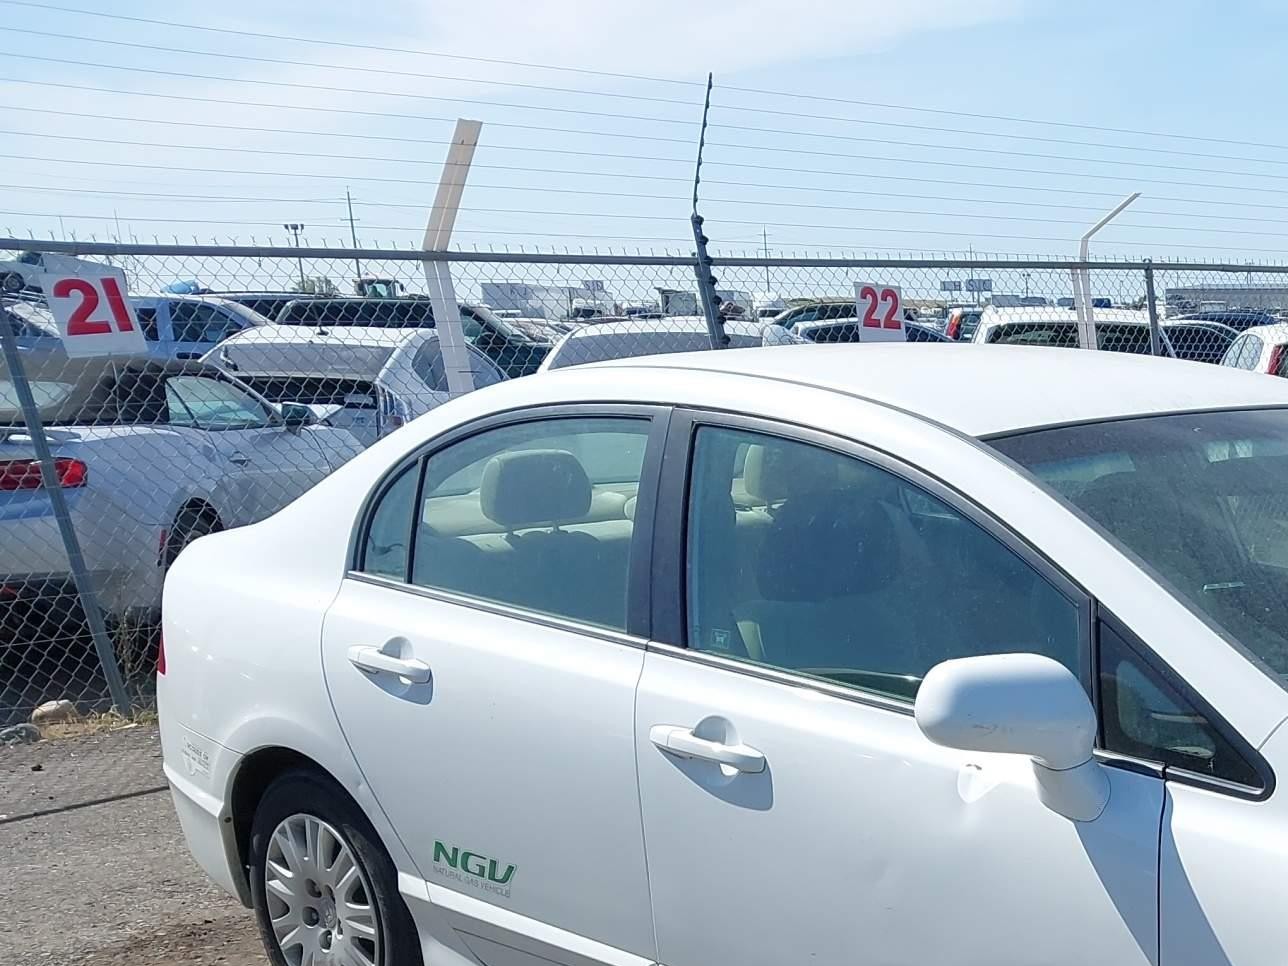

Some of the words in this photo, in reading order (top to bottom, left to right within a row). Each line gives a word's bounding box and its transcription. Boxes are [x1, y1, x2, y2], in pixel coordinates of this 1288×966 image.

[53, 277, 134, 336] 21
[859, 285, 902, 330] 22
[432, 865, 463, 882] NATURAL
[464, 875, 479, 888] GAS
[481, 881, 511, 898] VEHICLE
